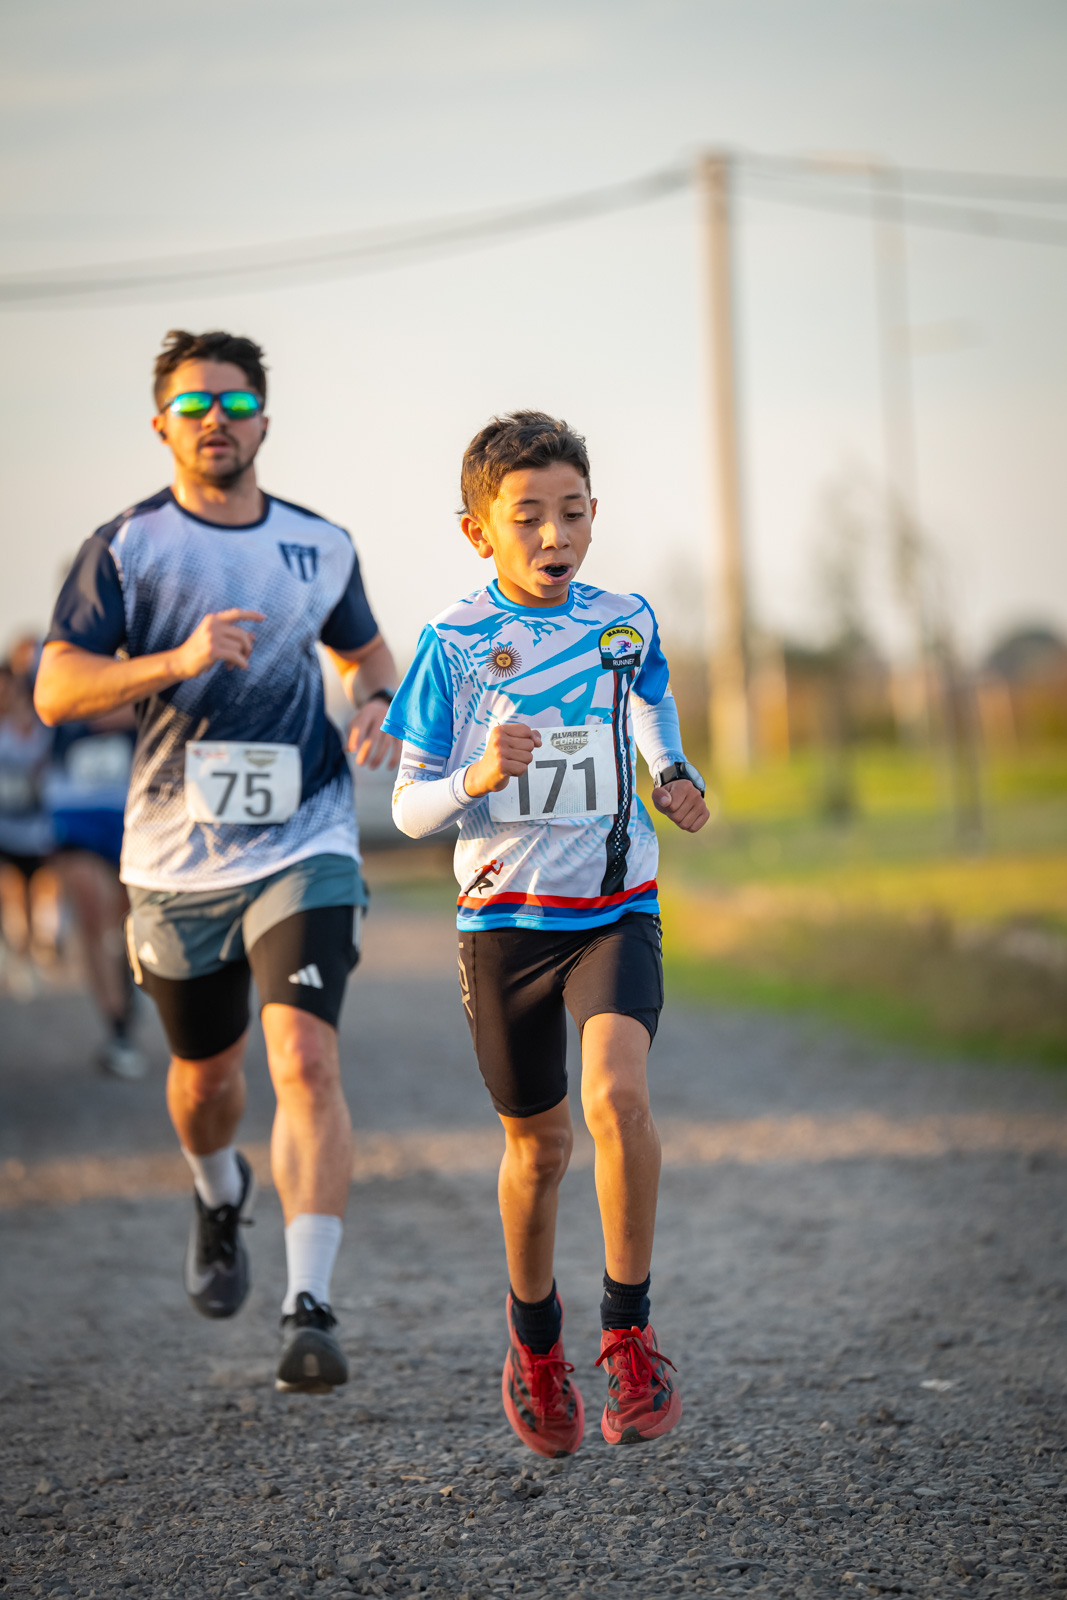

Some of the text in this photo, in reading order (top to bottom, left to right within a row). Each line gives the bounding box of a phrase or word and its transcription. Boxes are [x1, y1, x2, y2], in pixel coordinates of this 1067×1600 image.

[550, 730, 589, 740] ALVAREZ
[553, 736, 588, 747] CORRE
[211, 771, 272, 818] 75
[517, 757, 597, 815] 171
